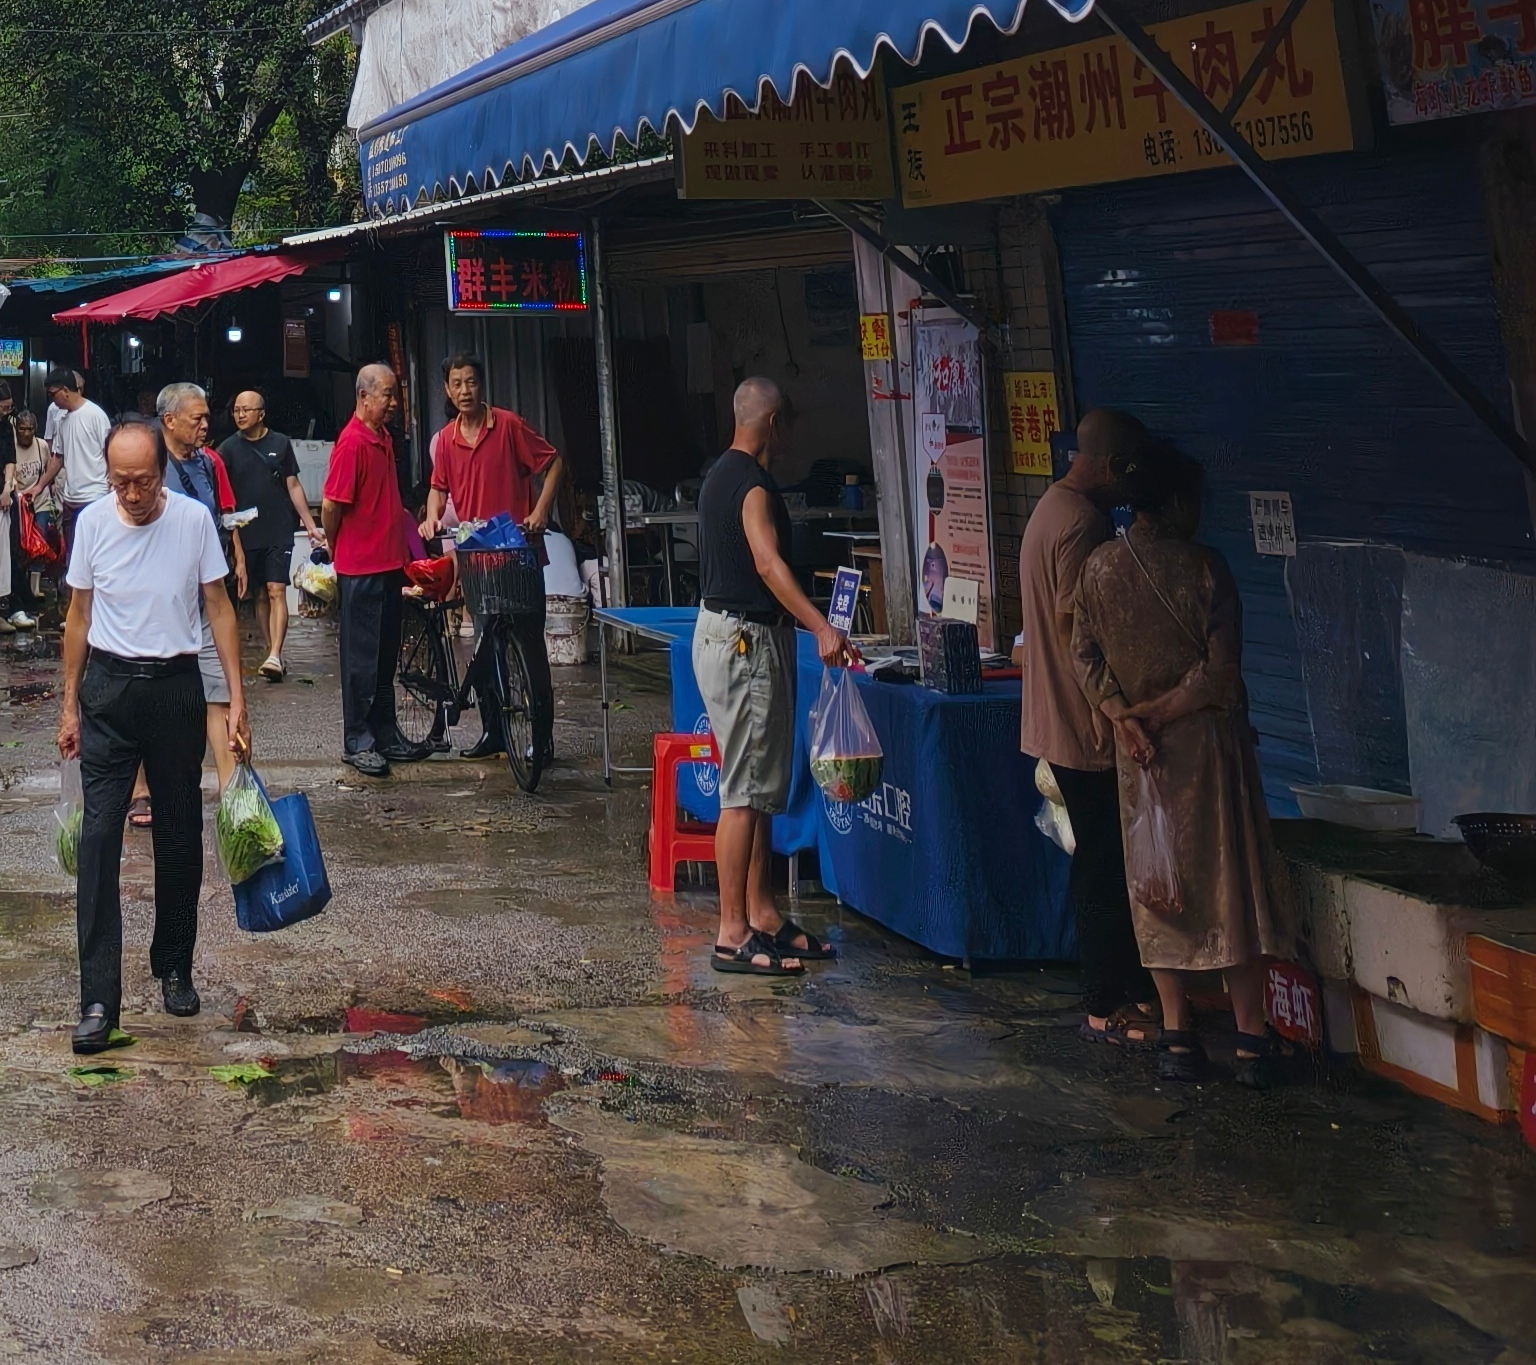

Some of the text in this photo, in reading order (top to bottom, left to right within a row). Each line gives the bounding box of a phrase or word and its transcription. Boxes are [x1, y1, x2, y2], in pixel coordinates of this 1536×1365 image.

[940, 7, 1314, 156] 正宗潮州牛肉丸
